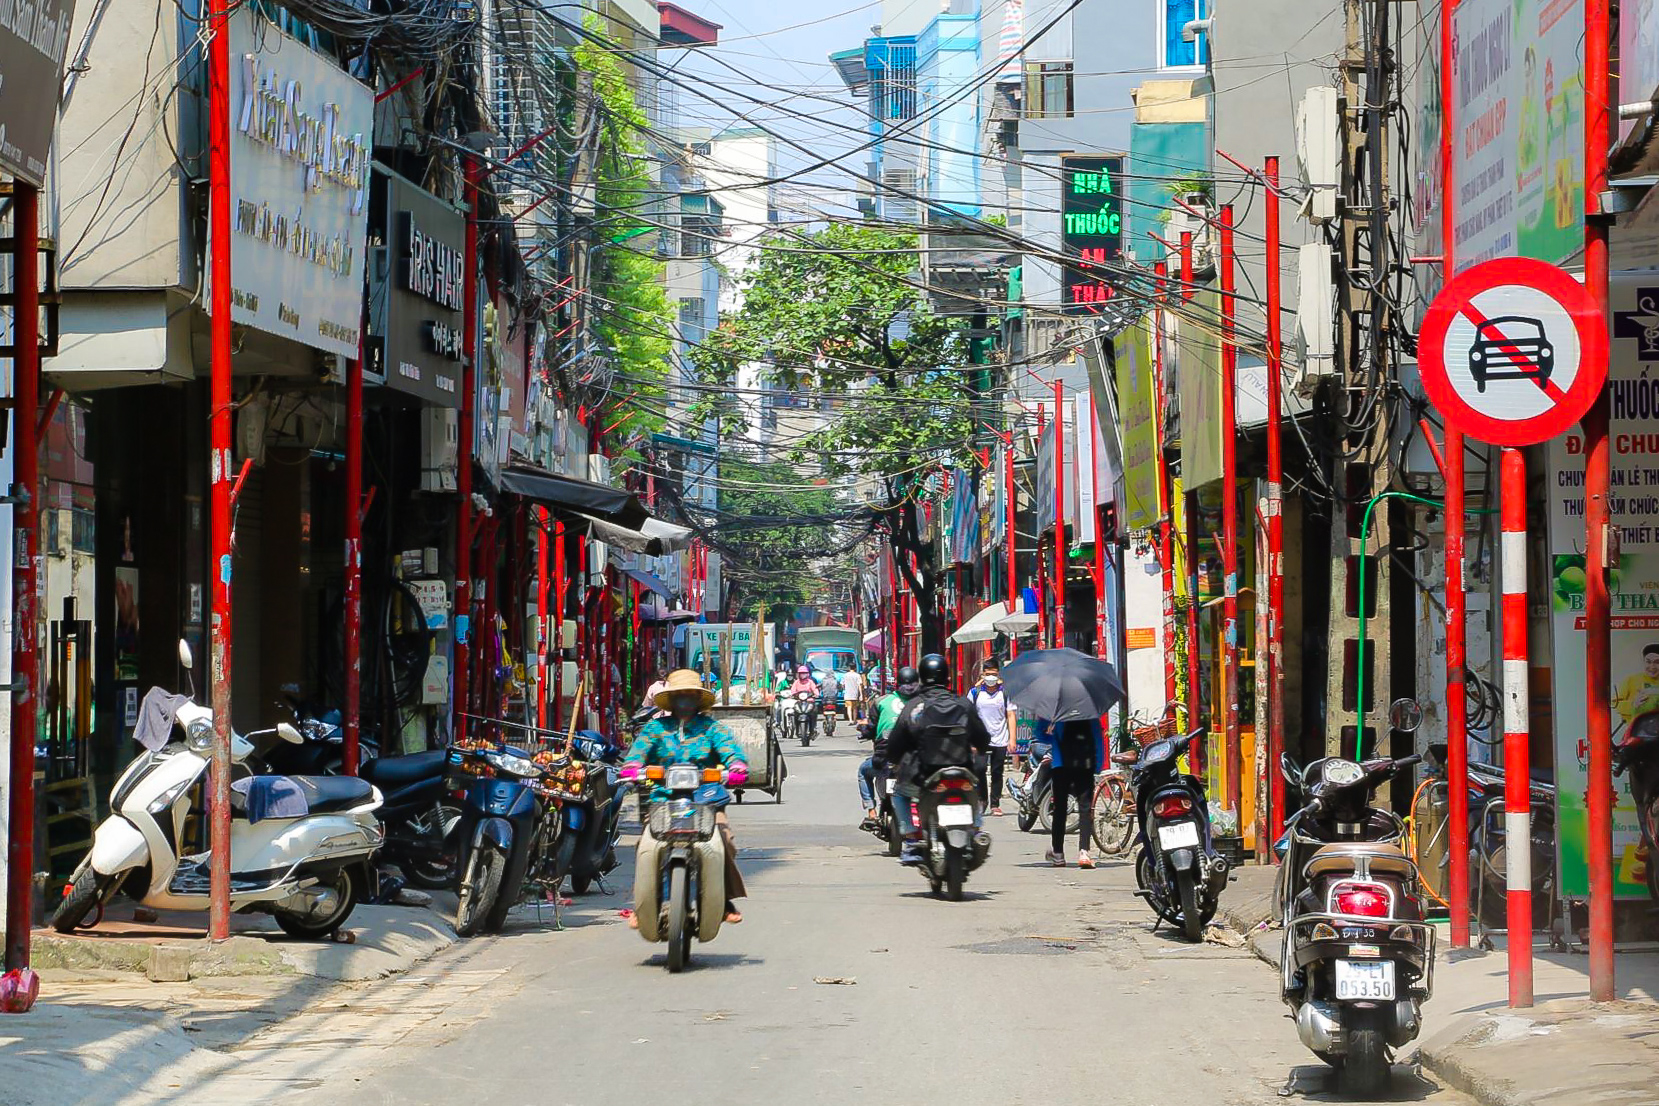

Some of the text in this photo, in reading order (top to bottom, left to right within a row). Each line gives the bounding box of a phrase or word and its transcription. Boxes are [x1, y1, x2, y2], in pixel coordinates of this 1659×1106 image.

[1074, 167, 1111, 193] NHÀ
[1065, 203, 1120, 234] THUỐC
[409, 210, 434, 298] IRIS
[1616, 434, 1659, 454] CHU
[1558, 470, 1586, 487] CHUY
[1621, 521, 1652, 543] THIẾT
[1628, 619, 1646, 628] CHO
[705, 632, 717, 641] XE
[1340, 980, 1391, 998] 053.50
